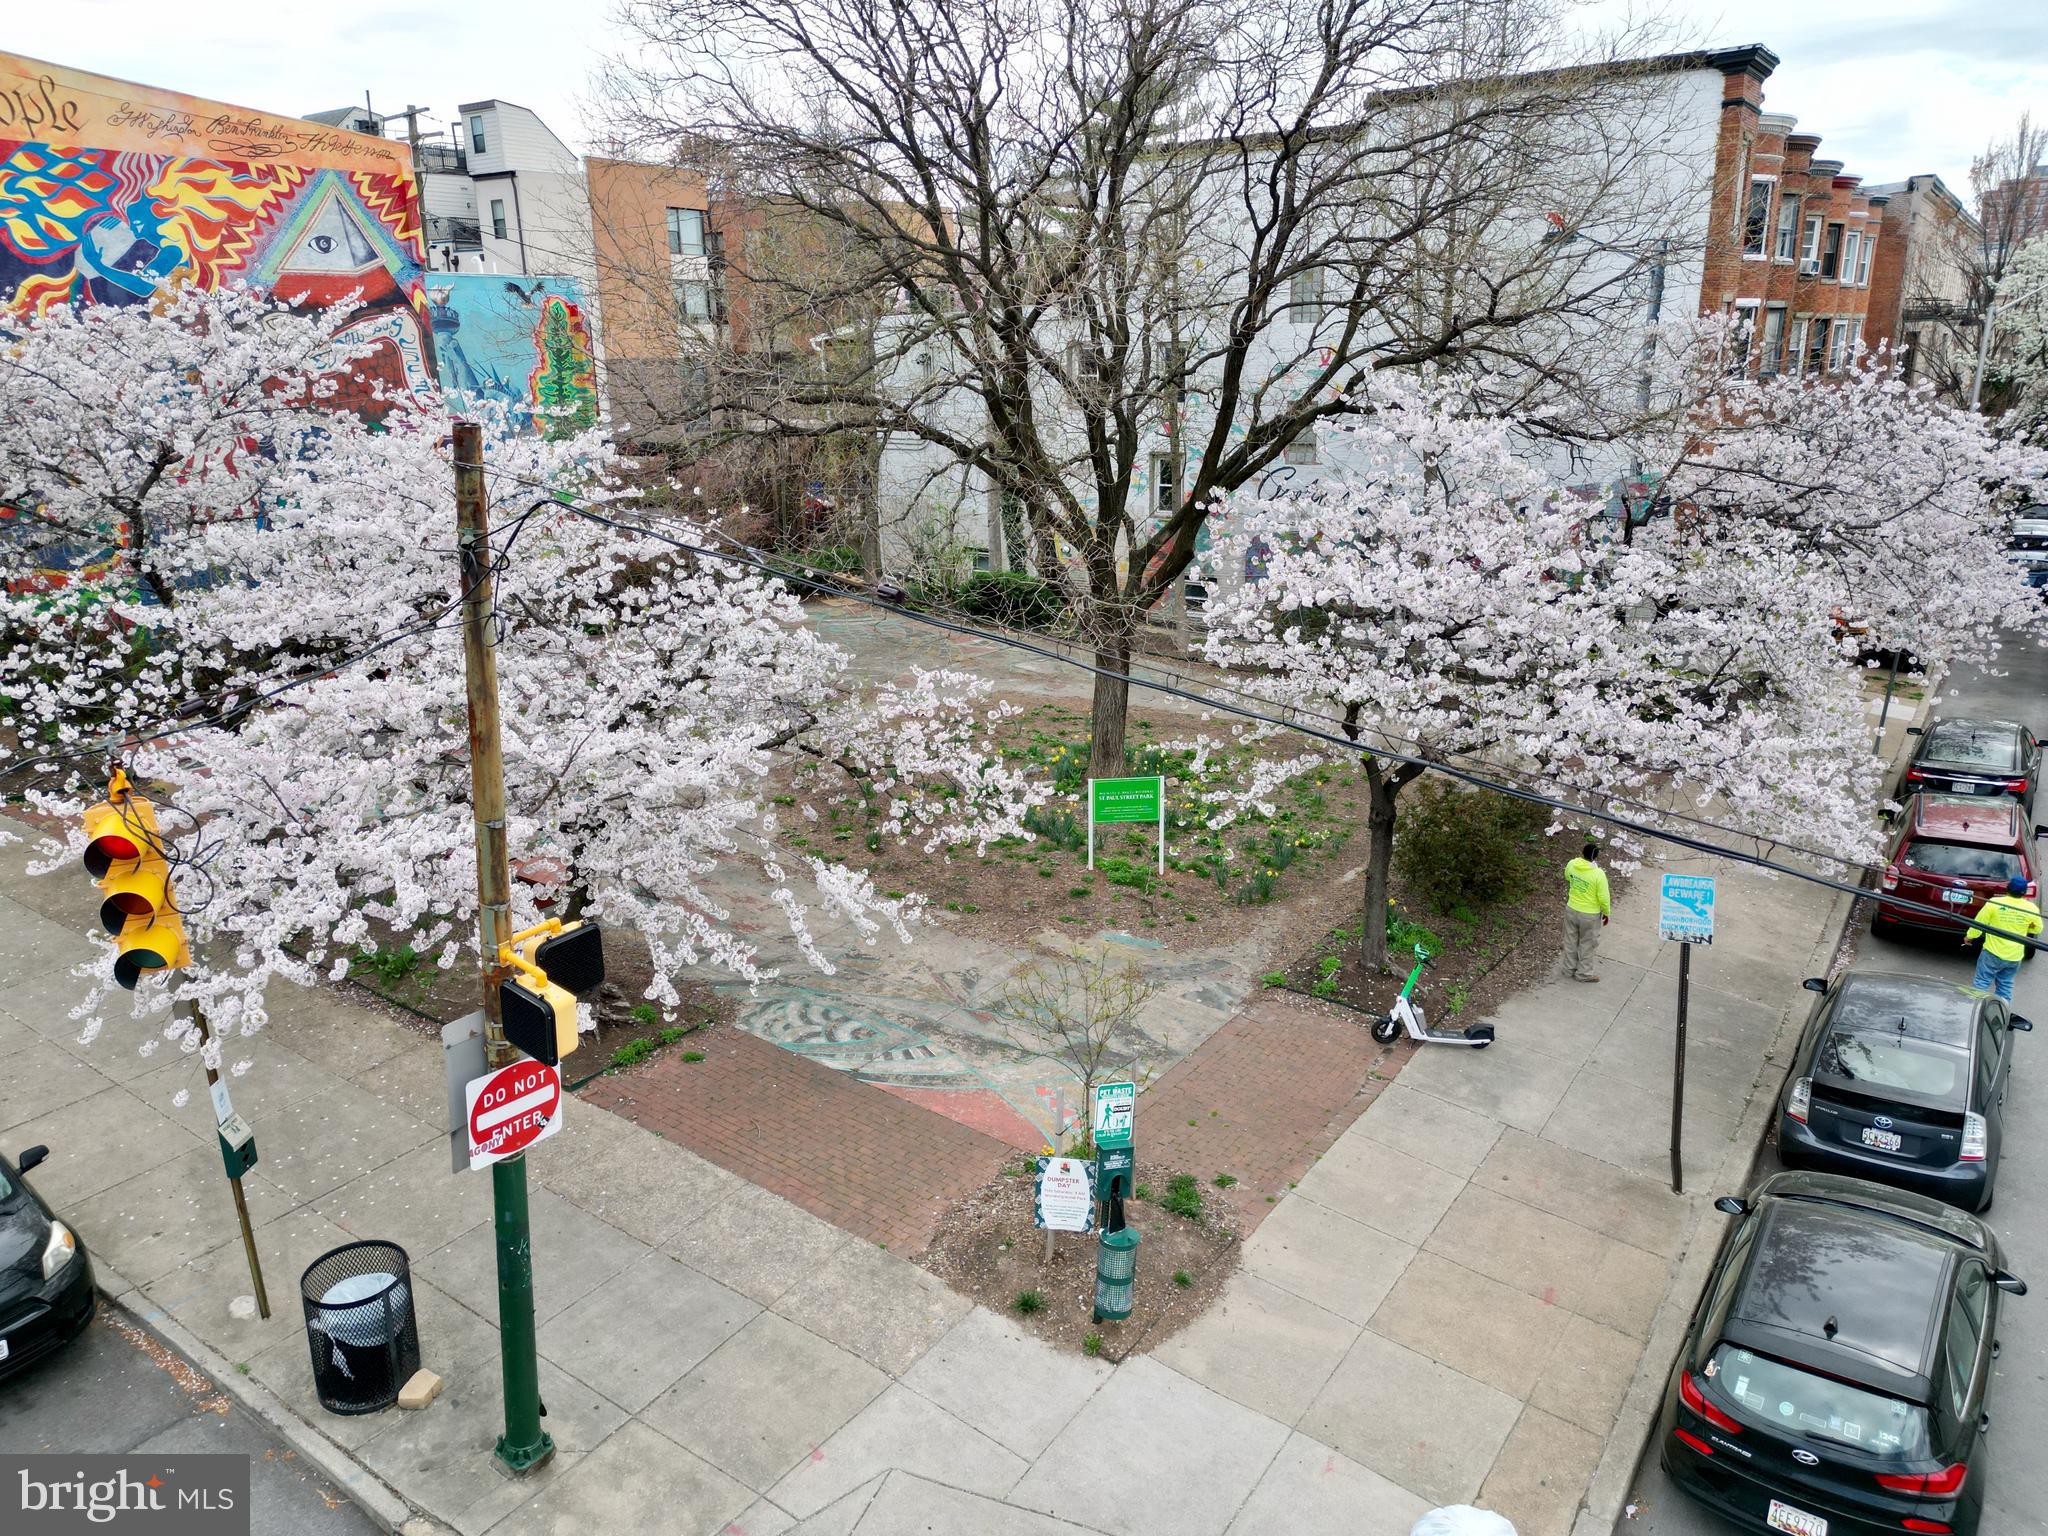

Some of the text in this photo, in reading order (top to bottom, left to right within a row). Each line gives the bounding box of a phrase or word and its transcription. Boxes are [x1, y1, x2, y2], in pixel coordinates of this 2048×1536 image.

[483, 1069, 546, 1108] DO NOT
[492, 1110, 541, 1139] ENTER
[1047, 1176, 1080, 1184] DUMPSTER
